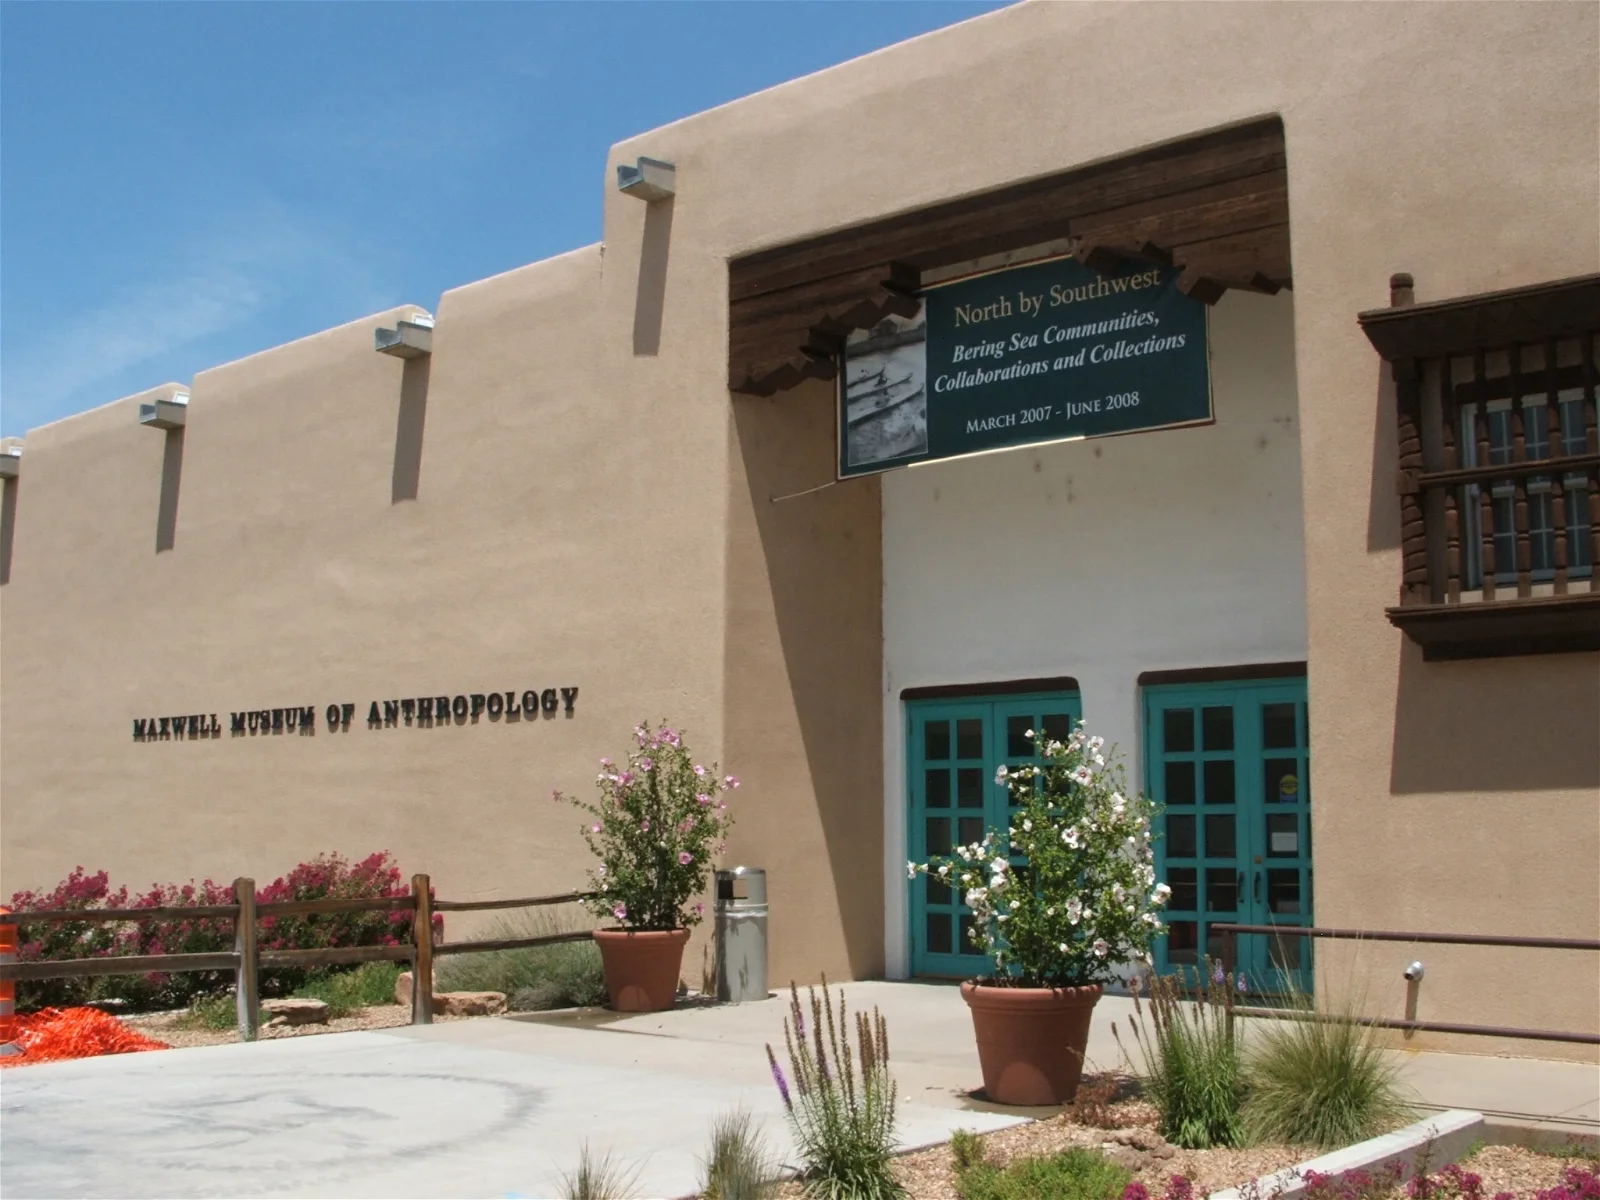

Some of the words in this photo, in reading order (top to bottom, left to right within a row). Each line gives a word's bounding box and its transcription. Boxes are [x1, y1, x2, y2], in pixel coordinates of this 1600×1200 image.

[954, 297, 1012, 327] North
[1019, 291, 1043, 318] by
[1049, 268, 1162, 307] Southwest
[934, 358, 1049, 393] Collaborations
[1053, 348, 1084, 370] and
[1089, 333, 1186, 364] Collections
[952, 339, 1005, 363] Bering
[1009, 332, 1038, 352] Sea
[1043, 309, 1160, 343] Communities,
[966, 413, 1016, 434] MARCH
[1020, 406, 1052, 424] 2007
[1066, 399, 1101, 420] JUNE
[1105, 391, 1140, 411] 2008
[133, 713, 221, 740] MAXWELL
[230, 706, 316, 734] MUSEUM
[326, 703, 355, 730] OF
[367, 687, 579, 726] ANTHROPOLOGY
